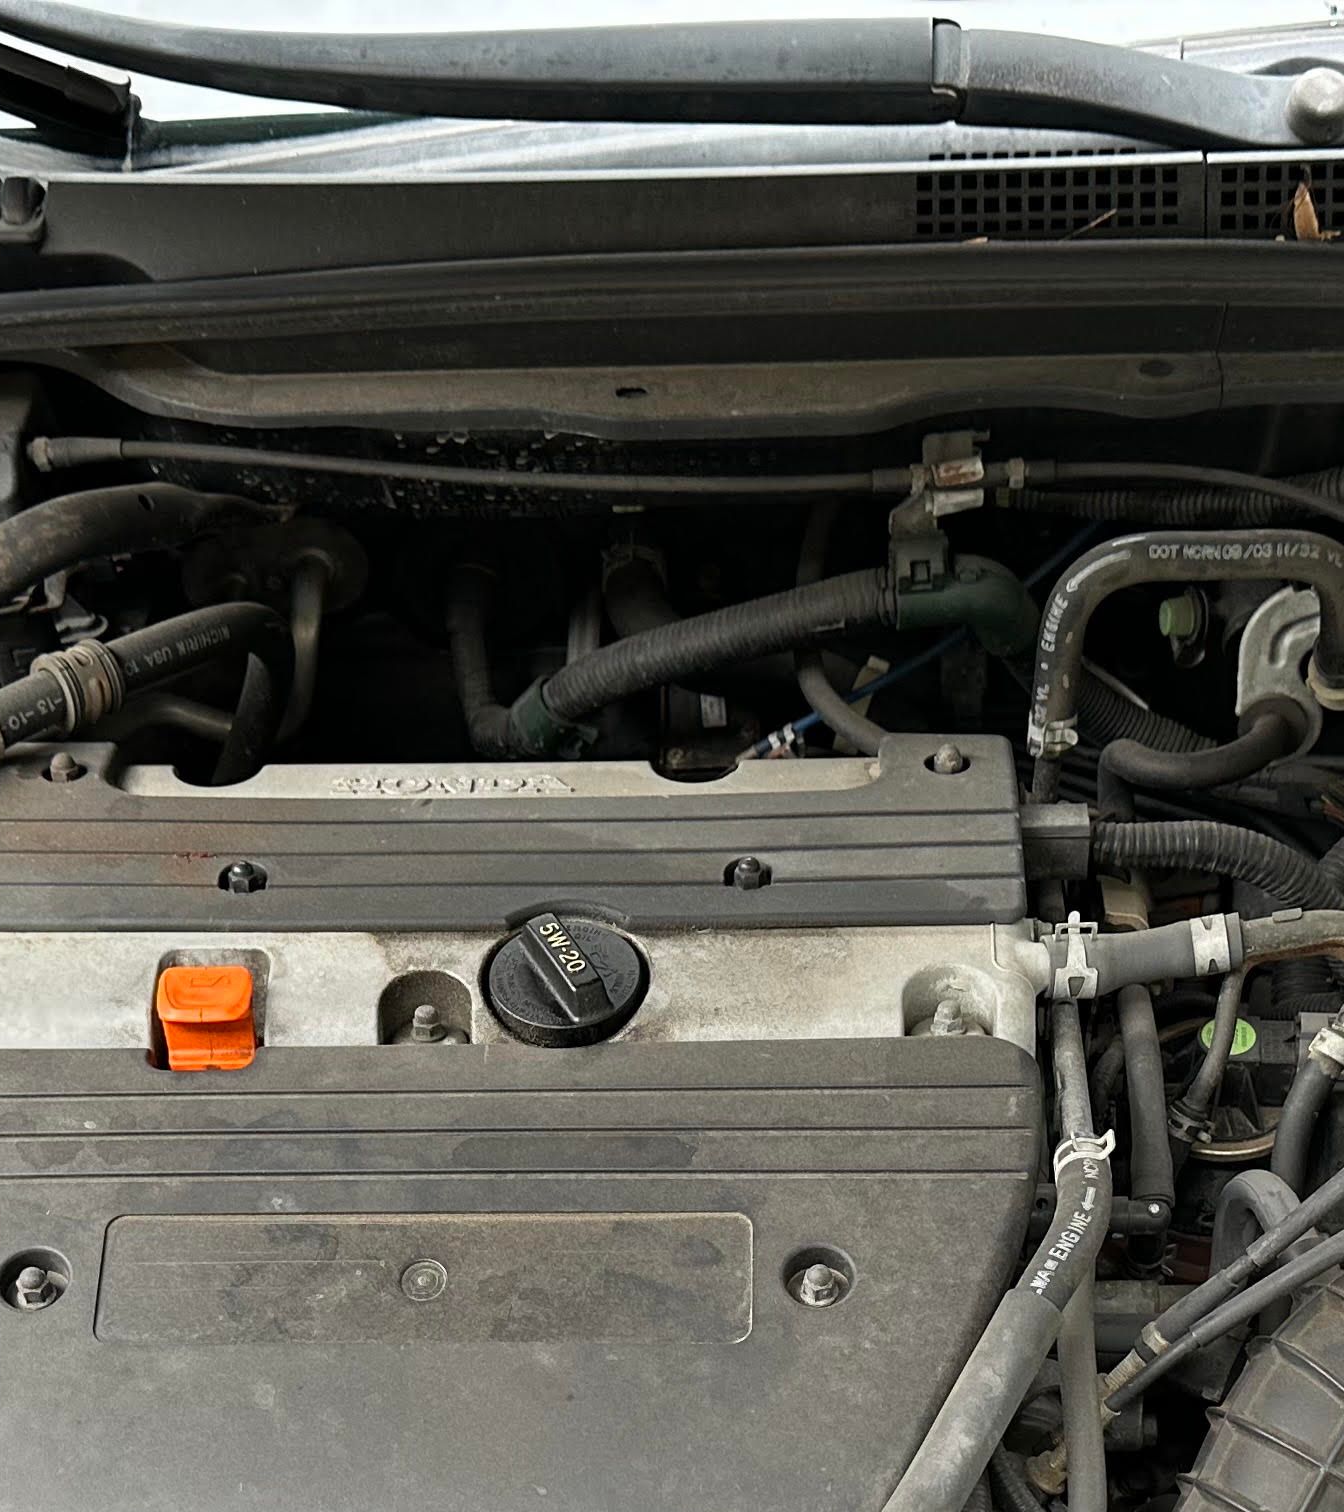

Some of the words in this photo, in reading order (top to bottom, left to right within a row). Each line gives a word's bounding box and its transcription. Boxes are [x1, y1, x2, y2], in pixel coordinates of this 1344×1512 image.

[330, 776, 575, 796] HONDA
[539, 922, 586, 975] 5W-20
[1048, 1210, 1092, 1262] ENGINE
